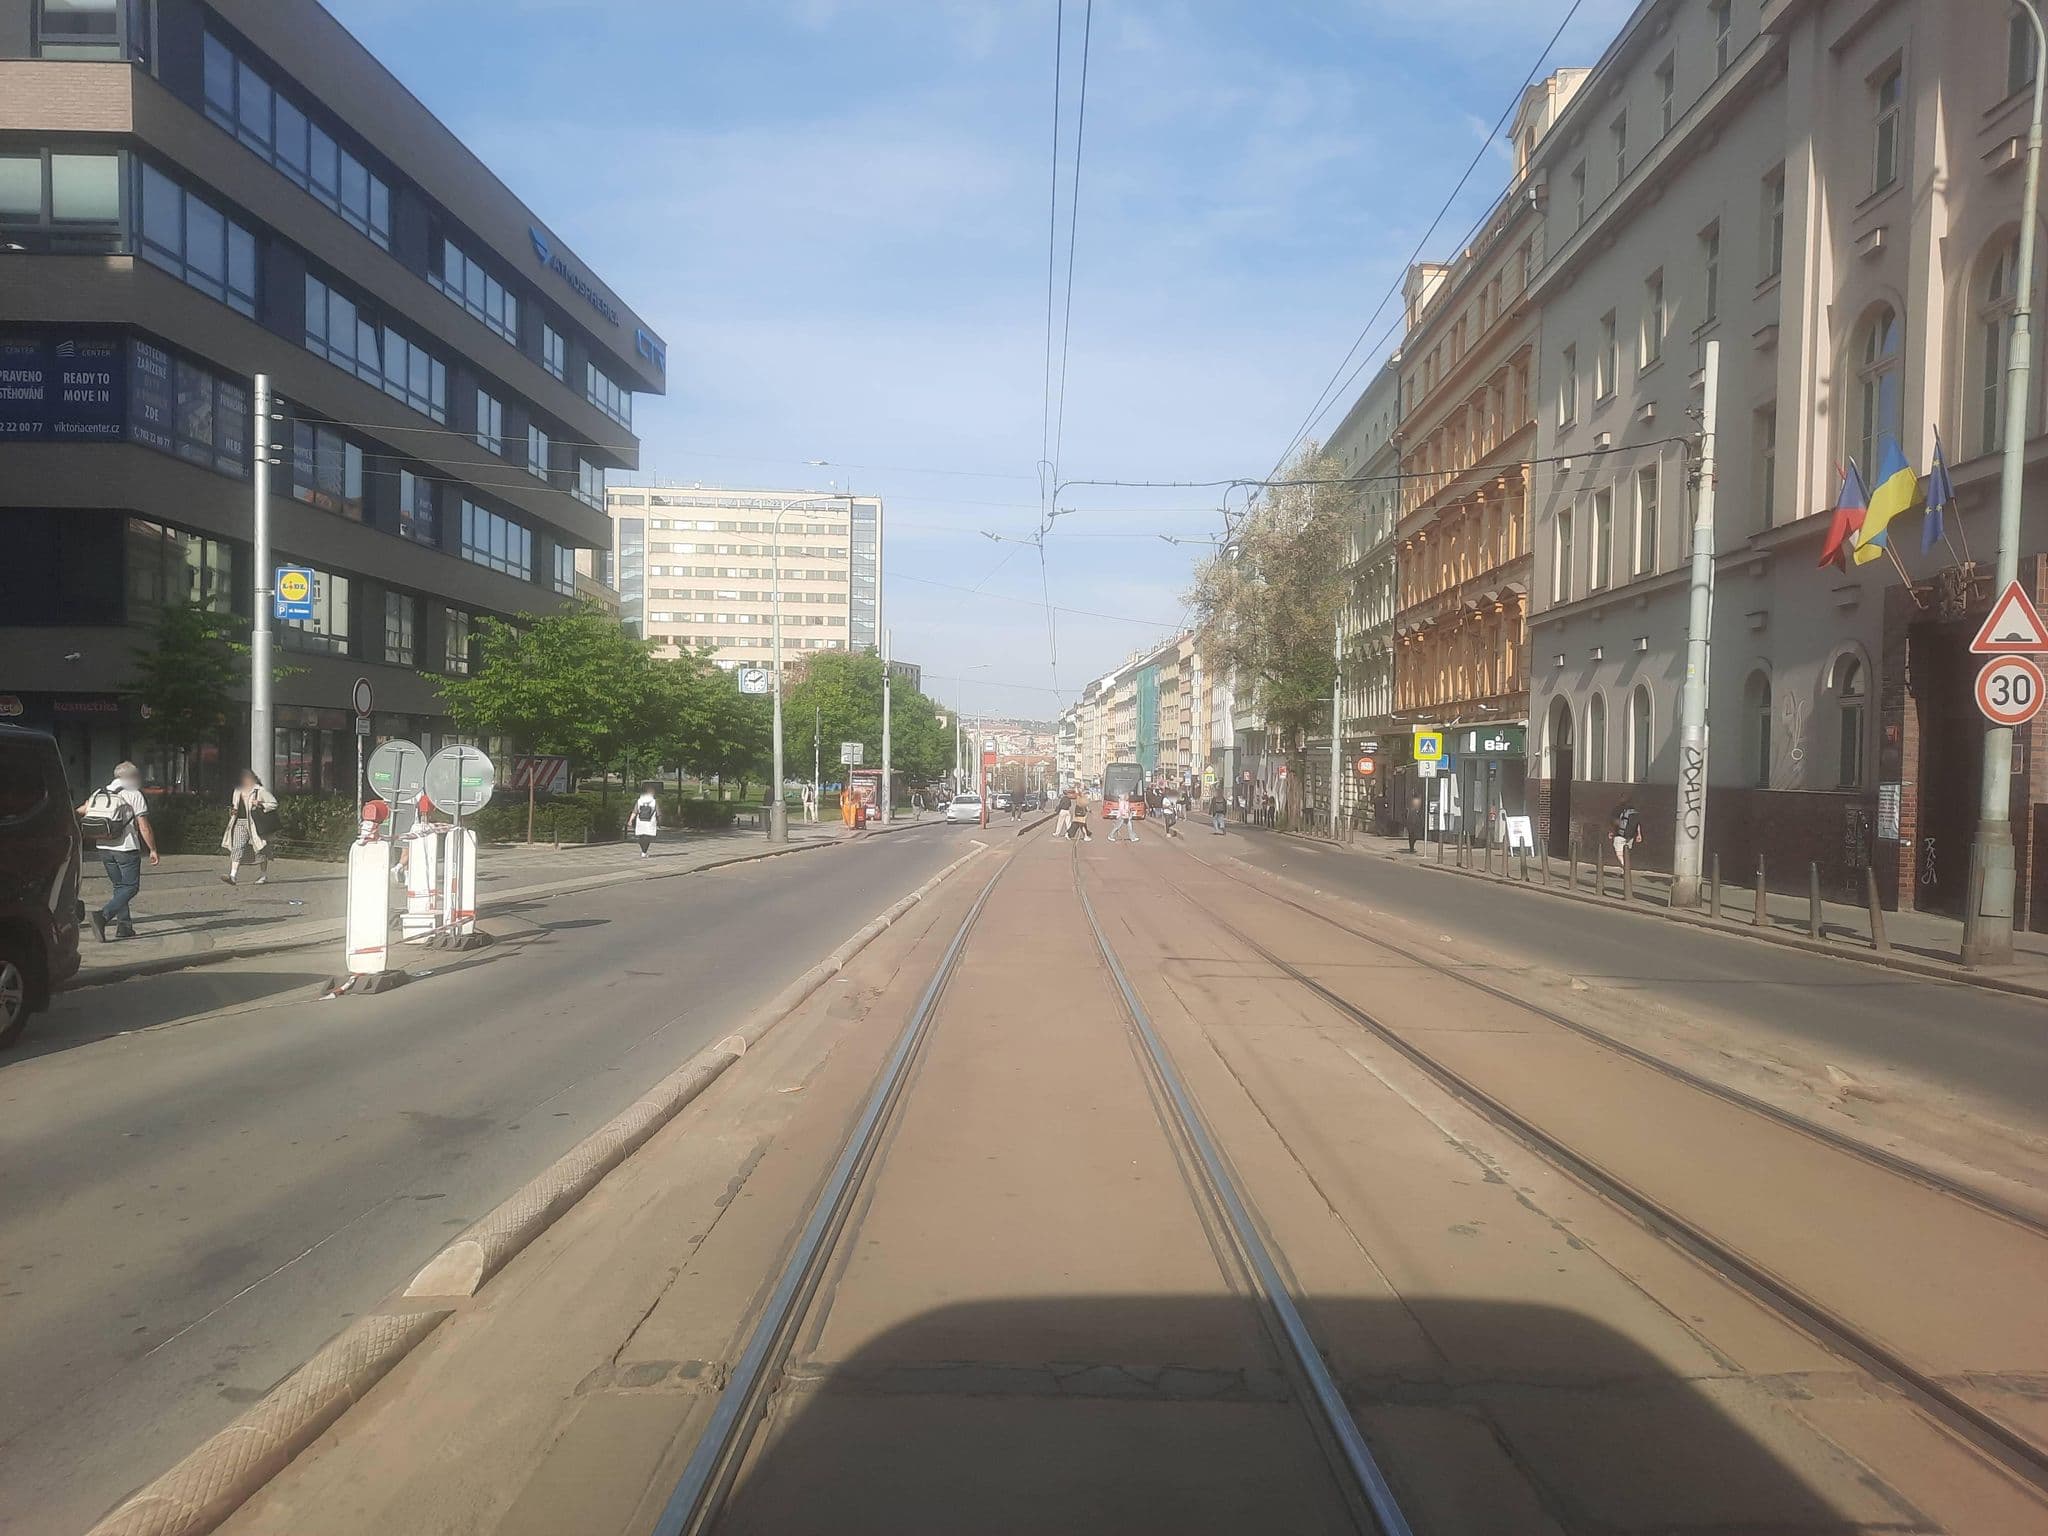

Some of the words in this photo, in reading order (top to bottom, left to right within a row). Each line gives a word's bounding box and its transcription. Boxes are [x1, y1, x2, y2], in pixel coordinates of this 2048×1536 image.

[63, 372, 96, 385] READY
[97, 372, 110, 385] TO
[63, 389, 95, 402] MOVE
[97, 389, 110, 402] IN
[6, 422, 17, 432] 22
[19, 422, 30, 432] 00
[32, 422, 43, 432] 77
[54, 421, 120, 434] viktoriacenter.cz
[1991, 674, 2032, 707] 30
[1484, 739, 1511, 751] Bar
